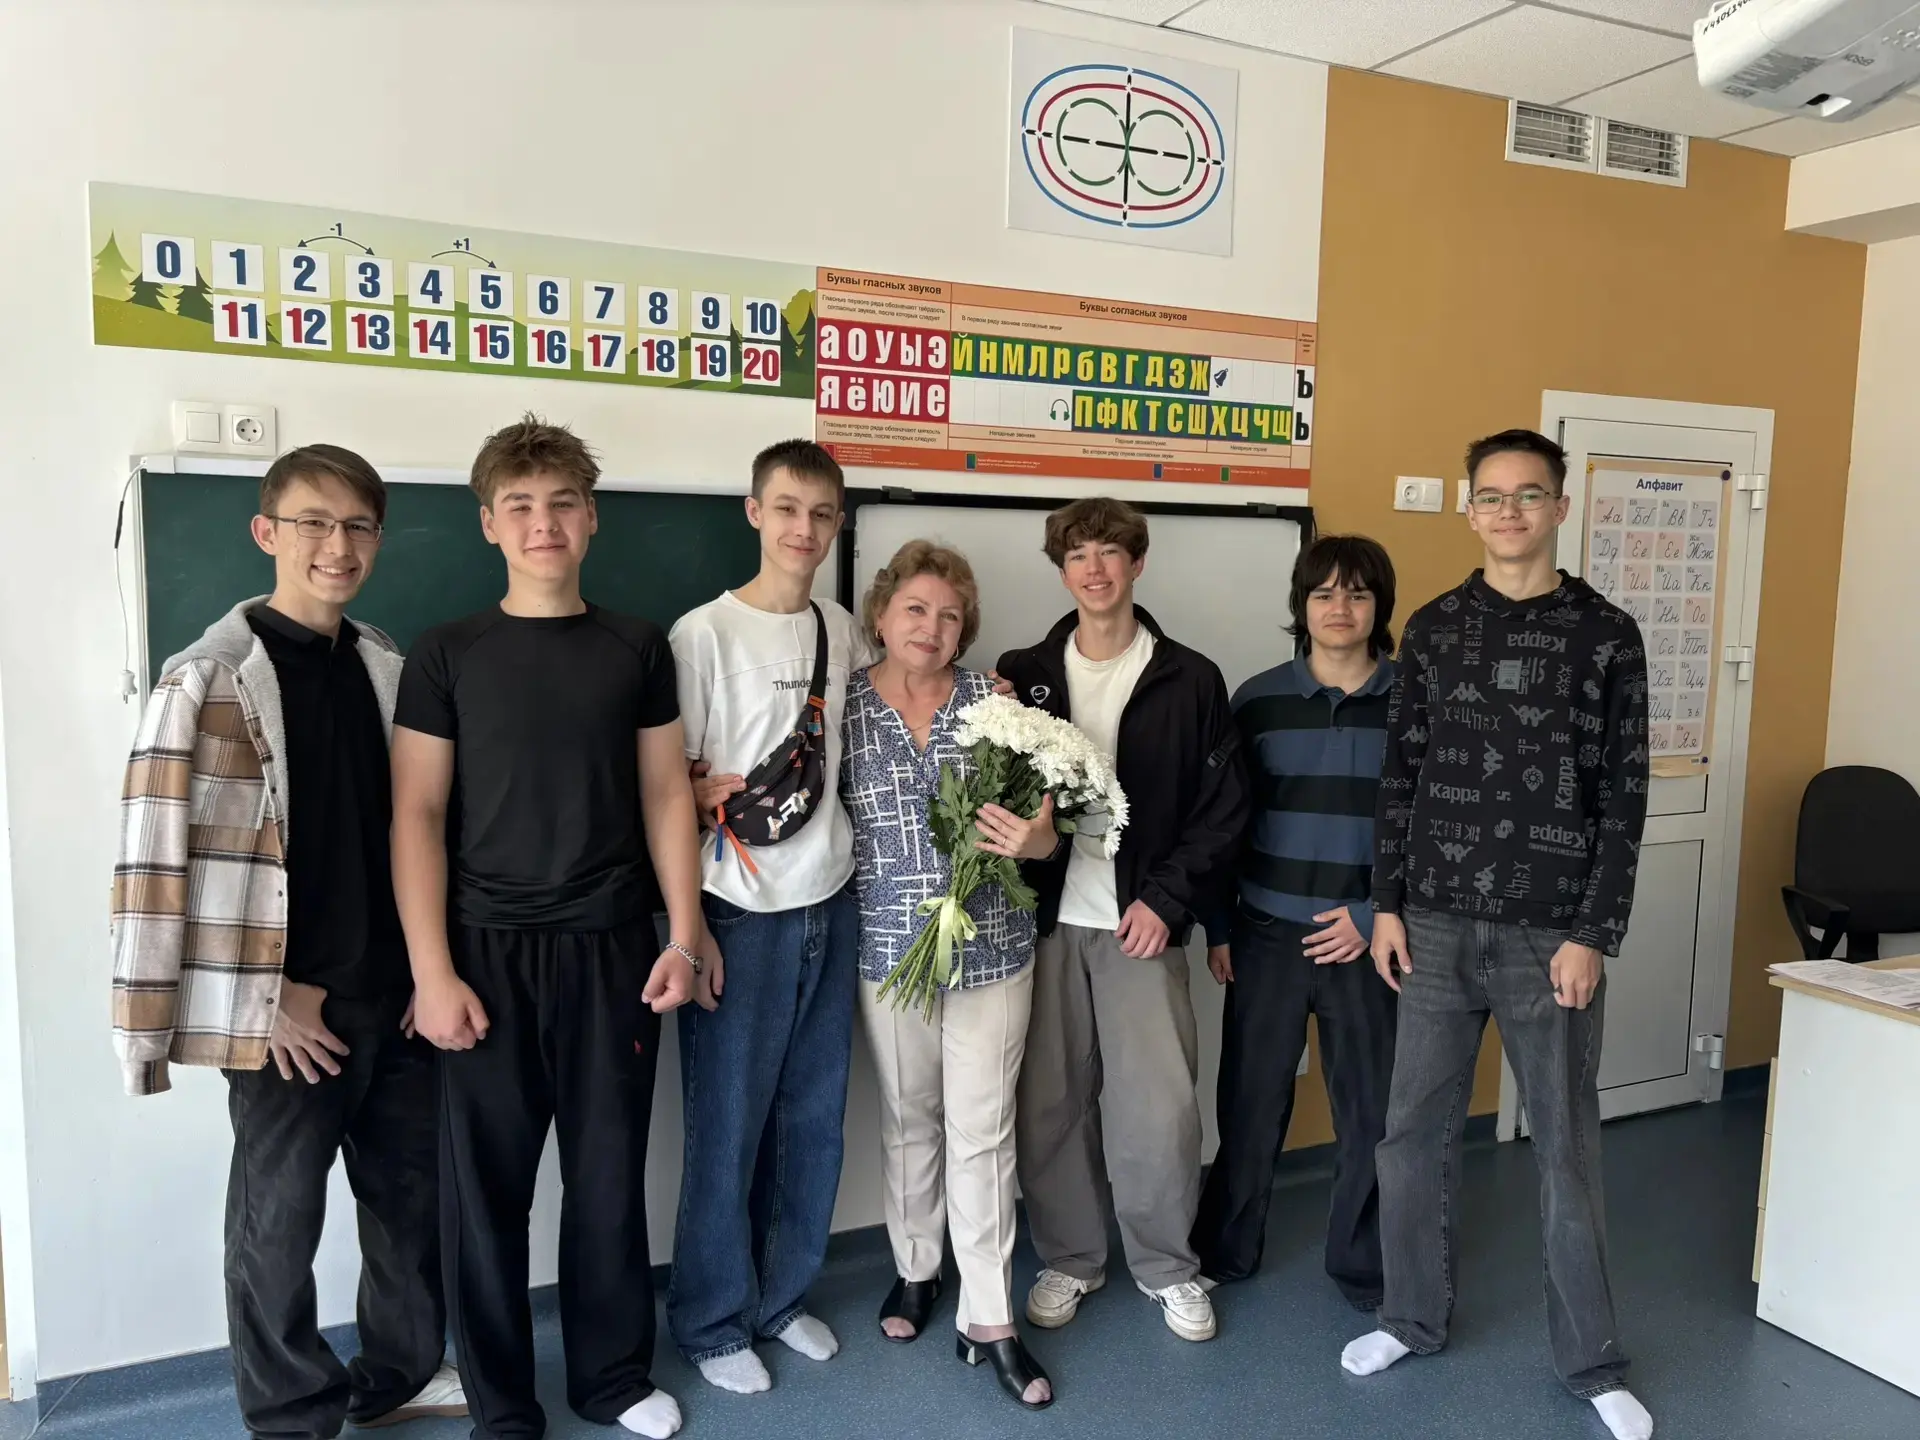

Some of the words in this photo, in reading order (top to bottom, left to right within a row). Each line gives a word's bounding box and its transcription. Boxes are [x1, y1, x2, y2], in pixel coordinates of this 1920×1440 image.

[330, 222, 342, 236] -1
[453, 238, 470, 251] +1
[157, 241, 181, 279] 0
[229, 248, 246, 286] 1
[293, 255, 317, 293] 2
[358, 262, 380, 299] 3
[420, 269, 443, 304] 4
[480, 274, 502, 310] 5
[539, 281, 559, 315] 6
[594, 286, 614, 319] 7
[649, 291, 668, 325] 8
[702, 297, 720, 330] 9
[746, 302, 777, 336] 10
[827, 272, 861, 285] Буквы
[863, 278, 906, 291] гласных
[908, 283, 942, 295] звуков
[1080, 300, 1109, 313] Буквы
[1110, 306, 1157, 318] согласных
[1158, 311, 1188, 322] звуков
[222, 301, 258, 339] 11
[287, 307, 327, 345] 12
[352, 313, 390, 351] 13
[413, 319, 451, 355] 14
[474, 324, 510, 360] 15
[532, 329, 567, 364] 16
[588, 335, 621, 368] 17
[642, 338, 675, 373] 18
[695, 344, 727, 378] 19
[744, 347, 779, 382] 20
[1635, 478, 1683, 493] Алфавит
[1507, 632, 1567, 654] Kappa
[1568, 706, 1604, 735] Kapp
[1429, 782, 1481, 804] Kappa
[1555, 756, 1578, 810] Kappa
[1529, 823, 1587, 850] Kappa
